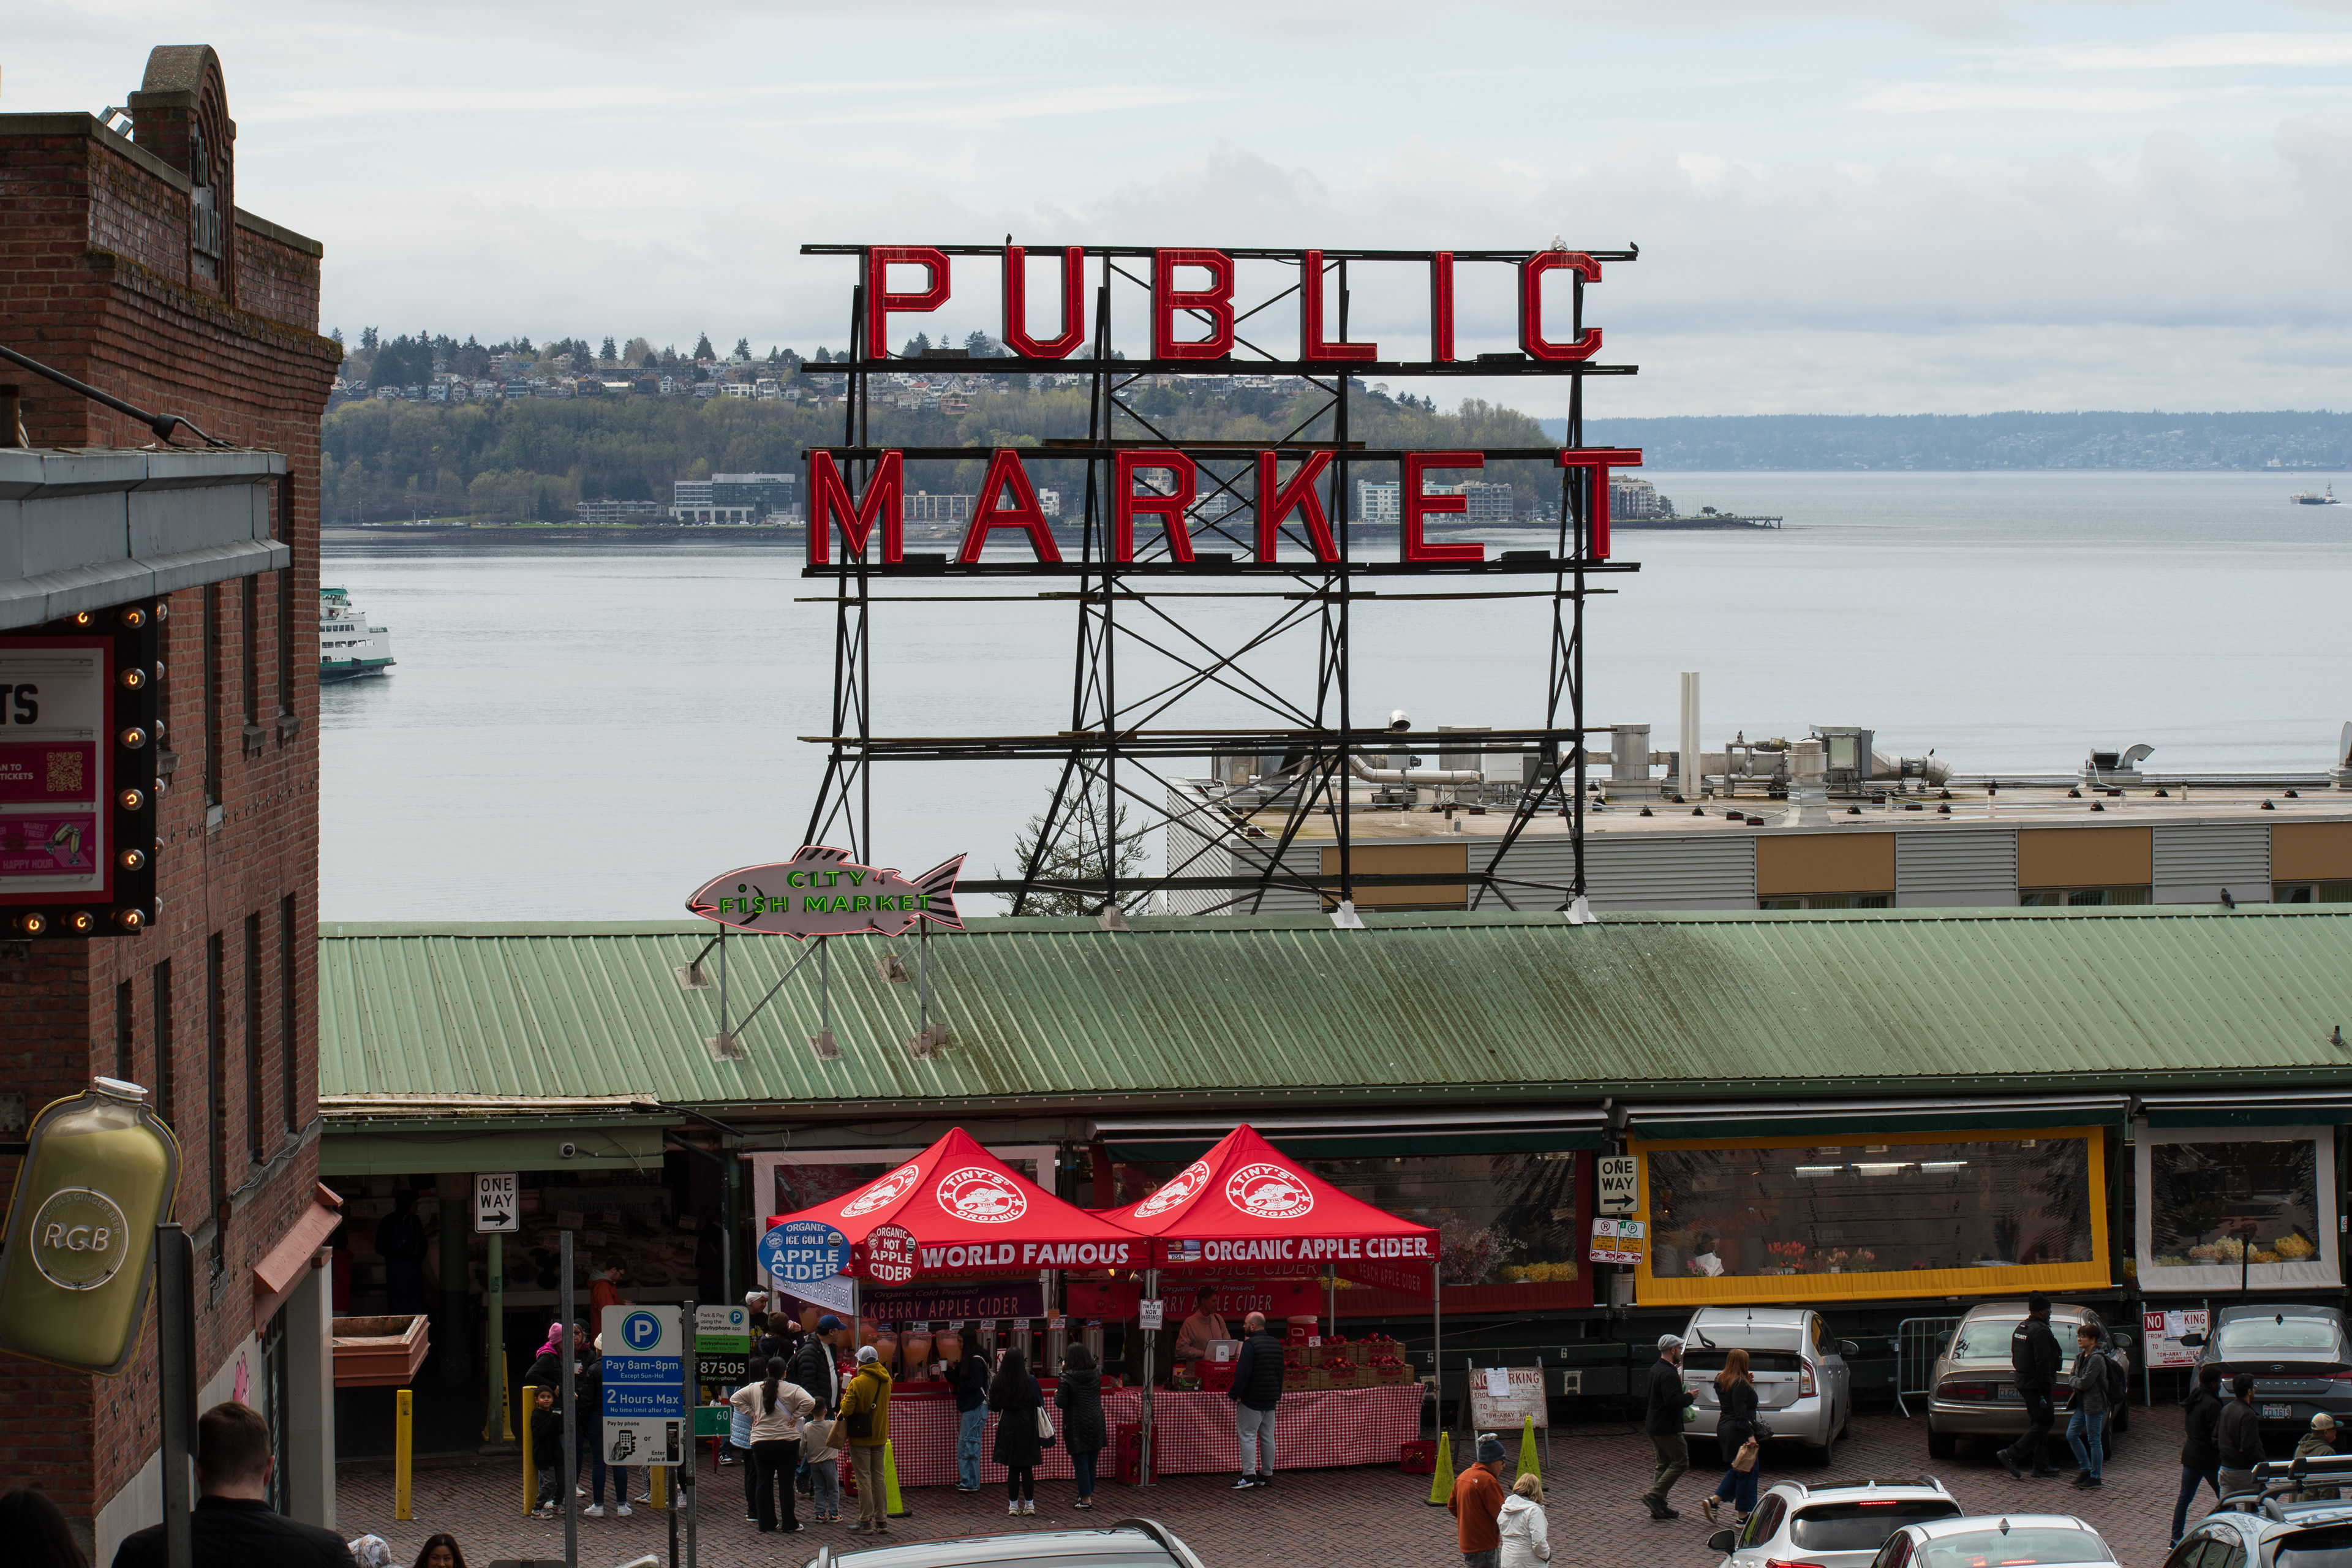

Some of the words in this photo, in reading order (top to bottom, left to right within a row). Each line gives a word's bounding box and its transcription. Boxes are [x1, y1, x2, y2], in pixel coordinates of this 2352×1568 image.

[864, 244, 1603, 361] PUBLIC
[807, 448, 1643, 565] MARKET
[24, 829, 45, 839] FRESH
[2, 859, 30, 870] HAPPY
[32, 859, 54, 869] HOUR
[786, 870, 868, 888] CITY
[718, 895, 789, 915] FISH
[802, 894, 933, 914] MARKET
[1234, 1166, 1291, 1184] TINY'S
[1602, 1161, 1633, 1175] ONE
[481, 1178, 513, 1192] ONE
[945, 1170, 1006, 1188] TINY'S
[1602, 1177, 1634, 1191] WAY
[481, 1194, 514, 1208] WAY
[615, 1203, 647, 1213] MARKET
[40, 1194, 72, 1227] RACHEL'S
[74, 1193, 110, 1213] GINGER
[107, 1210, 121, 1235] BEER
[956, 1208, 1019, 1222] ORGANIC
[1245, 1204, 1306, 1216] ORGANIC
[786, 1223, 826, 1232] ORGANIC
[876, 1227, 907, 1239] ORGANIC
[43, 1221, 112, 1252] RGB
[785, 1234, 799, 1245] ICE
[801, 1234, 824, 1245] COLD
[883, 1237, 900, 1250] HOT
[920, 1244, 1016, 1268] WORLD
[1023, 1243, 1129, 1265] FAMOUS
[1204, 1239, 1294, 1261] ORGANIC
[1298, 1238, 1362, 1260] APPLE
[1366, 1237, 1428, 1258] CIDER
[771, 1250, 839, 1263] APPLE
[870, 1250, 913, 1264] APPLE
[771, 1263, 839, 1280] CIDER
[870, 1263, 912, 1281] CIDER
[1205, 1264, 1256, 1276] SPICE
[1263, 1264, 1317, 1275] CIDER
[1359, 1263, 1378, 1283] PEACH
[1380, 1268, 1400, 1287] APPLE
[1402, 1273, 1421, 1292] CIDER
[813, 1281, 831, 1303] APPLE
[832, 1286, 849, 1309] CIDER
[874, 1290, 912, 1299] Organic
[861, 1300, 922, 1320] CKBERRY
[929, 1298, 970, 1317] APPLE
[978, 1297, 1019, 1316] CIDER
[1235, 1294, 1272, 1312] CIDER
[2146, 1315, 2162, 1329] NO
[2184, 1314, 2205, 1324] KING
[606, 1360, 625, 1371] Pay
[627, 1360, 679, 1371] 8am-8pm
[700, 1362, 745, 1374] 87505
[1509, 1373, 1539, 1384] RKING
[607, 1390, 616, 1404] 2
[620, 1394, 653, 1404] Hours
[656, 1394, 679, 1404] Max
[716, 1411, 728, 1420] 60
